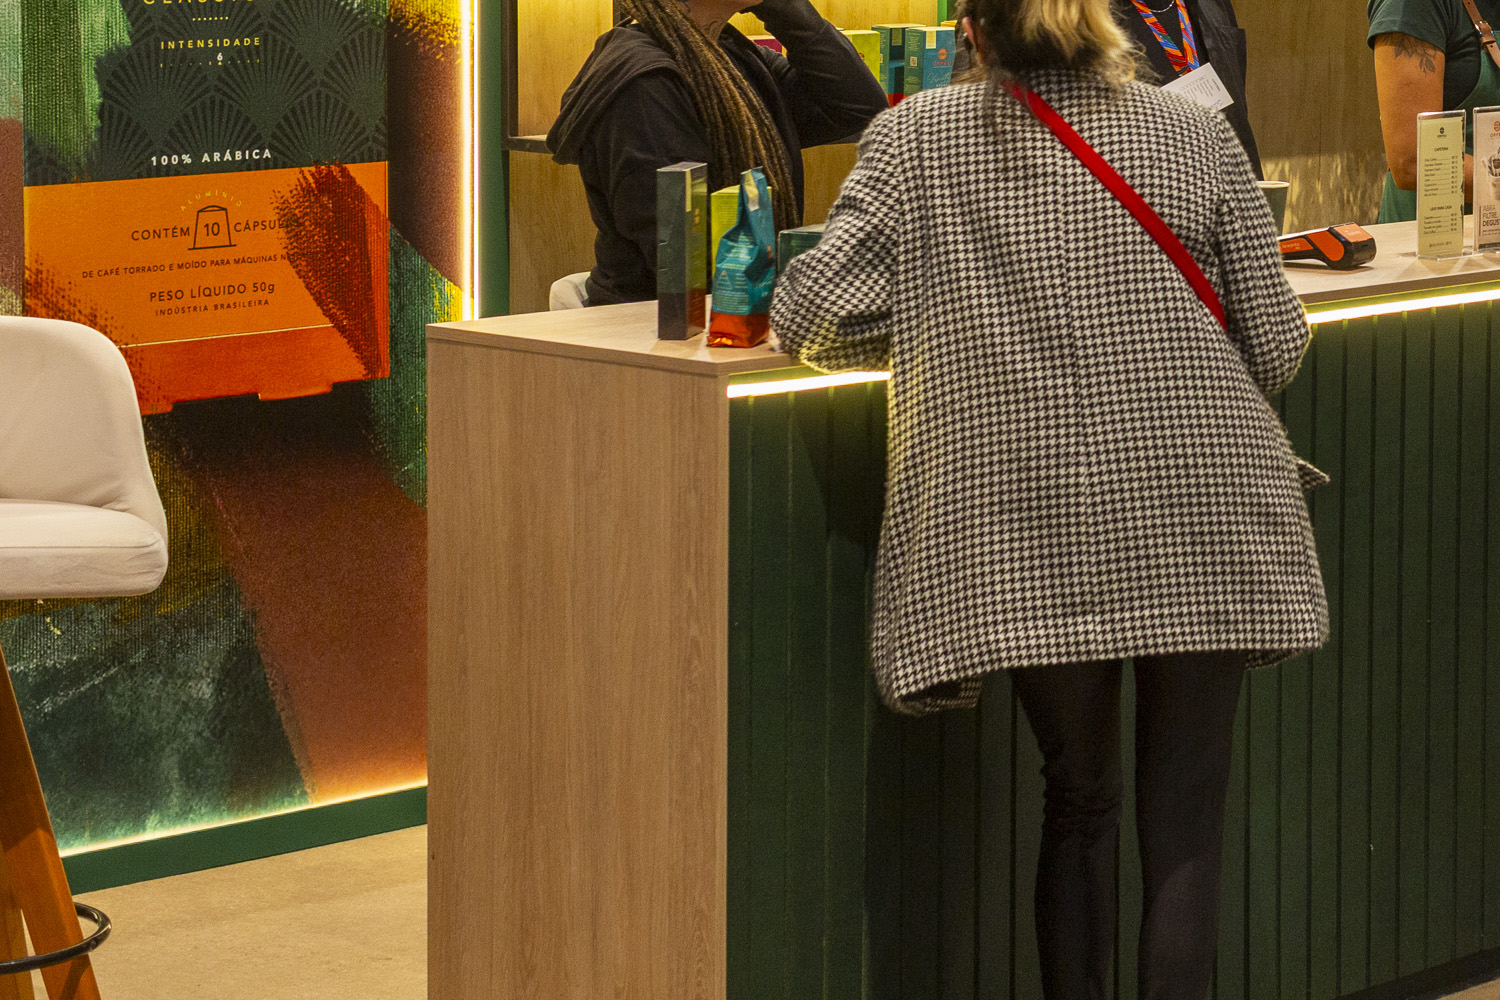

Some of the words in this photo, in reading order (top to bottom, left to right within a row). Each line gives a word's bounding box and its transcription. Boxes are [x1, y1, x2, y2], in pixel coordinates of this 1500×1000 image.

[160, 37, 261, 50] INTENSIDADE
[216, 52, 224, 62] 6
[151, 153, 192, 166] 100%
[201, 148, 272, 164] ARÁBICA
[131, 224, 191, 242] CONTÉM
[203, 222, 221, 237] 10
[82, 271, 94, 279] DE
[97, 267, 120, 278] CAFÉ
[123, 264, 166, 275] TORRADO
[177, 260, 207, 270] MOÍDO
[210, 259, 231, 267] PARA
[233, 254, 278, 265] MÁQUINAS
[150, 289, 184, 302] PESO
[190, 283, 246, 299] LÍQUIDO
[252, 282, 275, 294] 50g
[155, 304, 209, 317] INDÚSTRIA
[213, 299, 270, 311] BRASILEIRA
